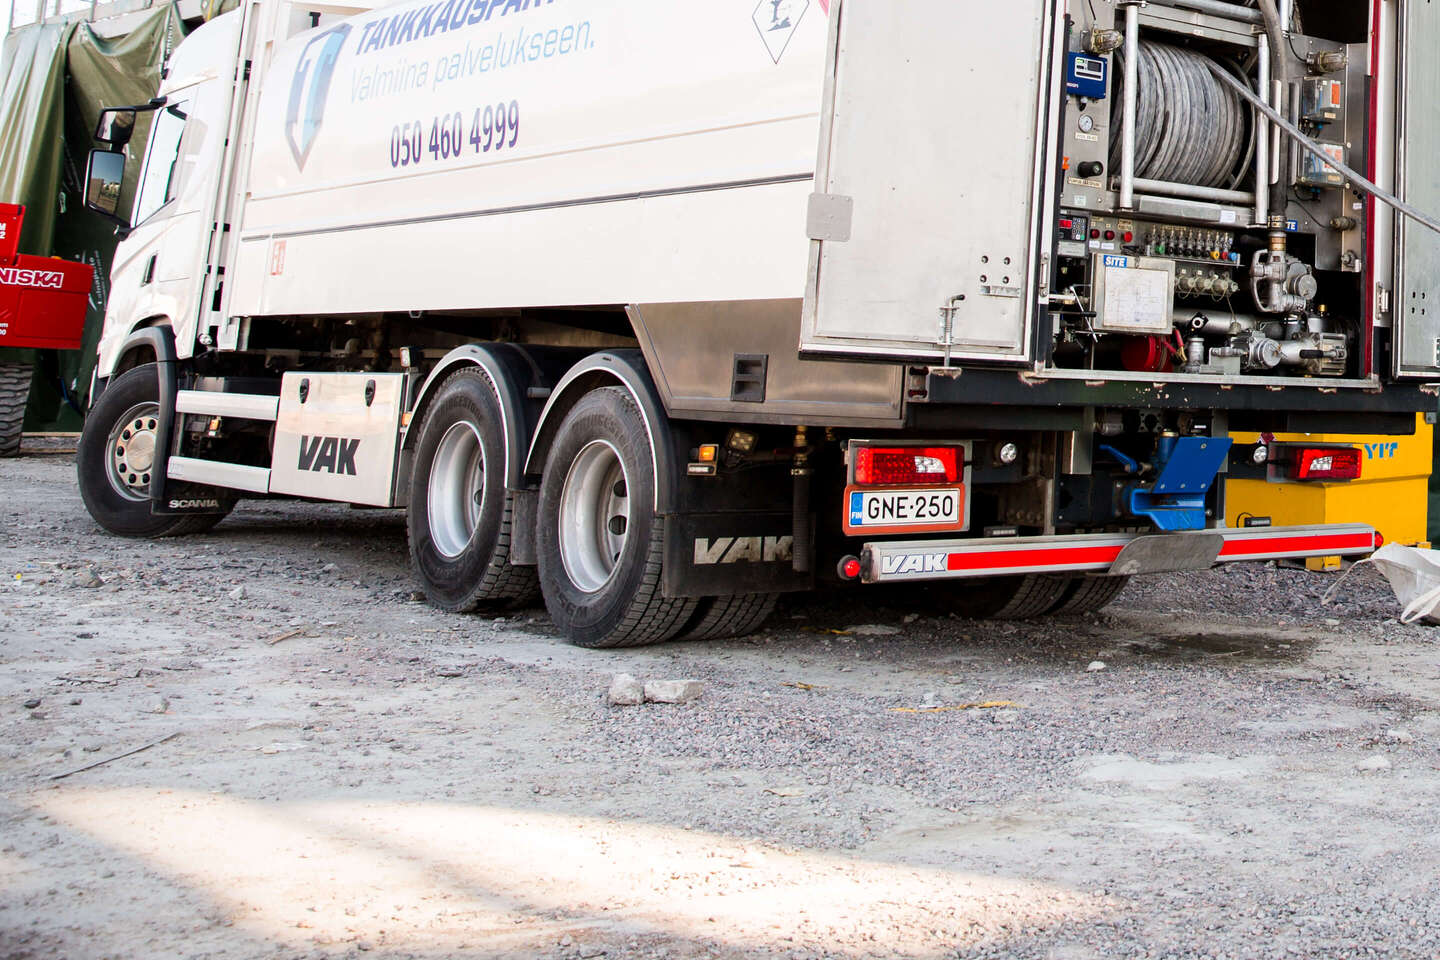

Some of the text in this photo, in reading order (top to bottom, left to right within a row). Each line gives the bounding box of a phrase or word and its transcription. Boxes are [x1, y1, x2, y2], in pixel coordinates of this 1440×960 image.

[351, 19, 595, 104] Valmiina palvelukseen.
[390, 100, 520, 168] 050 460 4999
[1105, 256, 1125, 268] SITE
[297, 434, 360, 476] VAK
[1364, 442, 1398, 460] YIT
[168, 499, 220, 509] SCANIA
[694, 536, 793, 565] VAK
[881, 552, 947, 574] VAK
